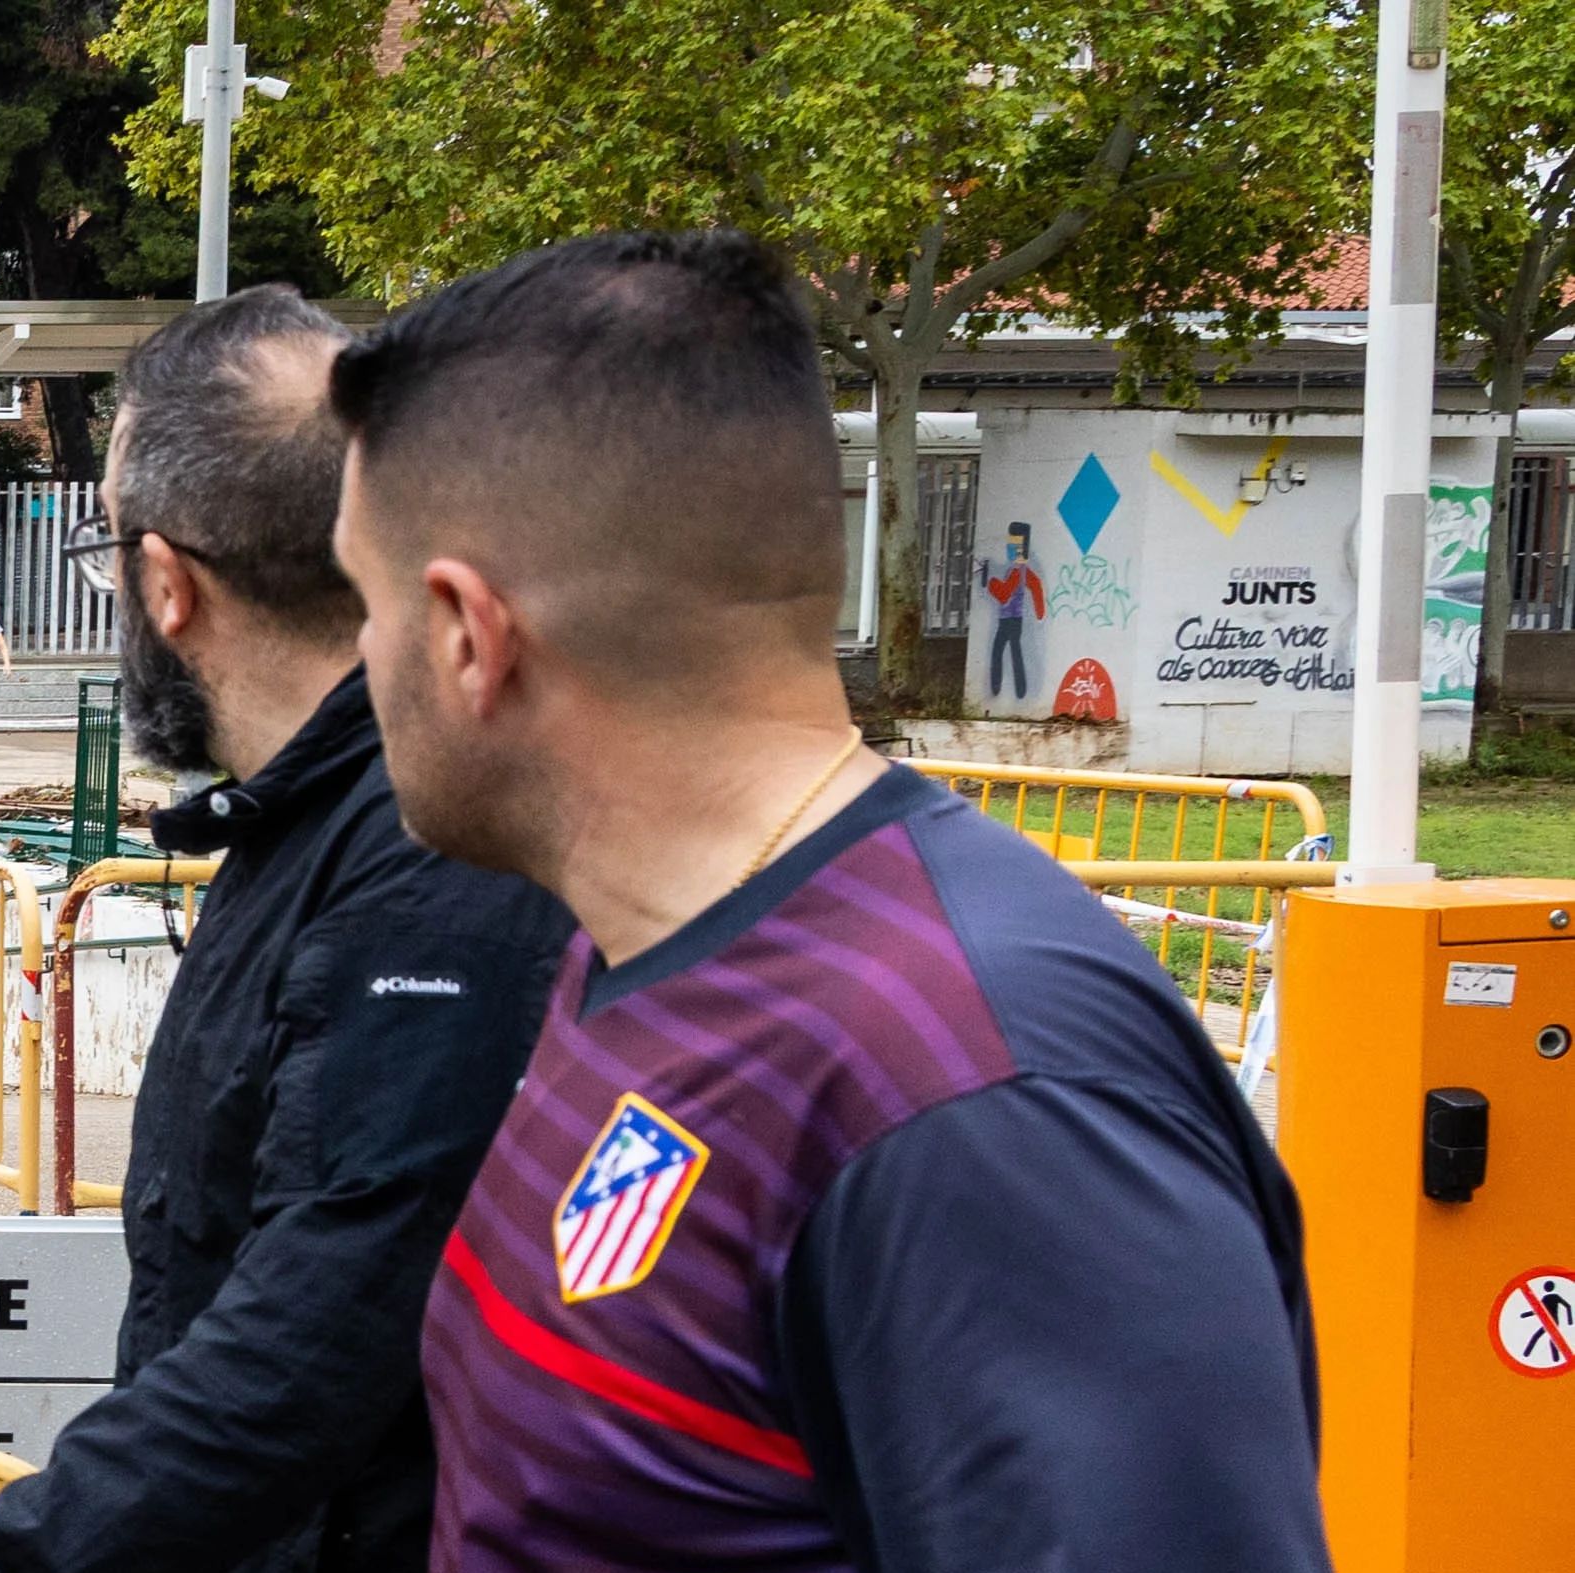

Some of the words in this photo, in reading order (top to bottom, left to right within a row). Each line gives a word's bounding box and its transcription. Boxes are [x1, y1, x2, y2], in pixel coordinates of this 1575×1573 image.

[1229, 566, 1311, 580] CAMINEM
[1221, 581, 1317, 605] JUNTS
[1175, 615, 1266, 650] Cultura
[388, 976, 461, 995] Columbia
